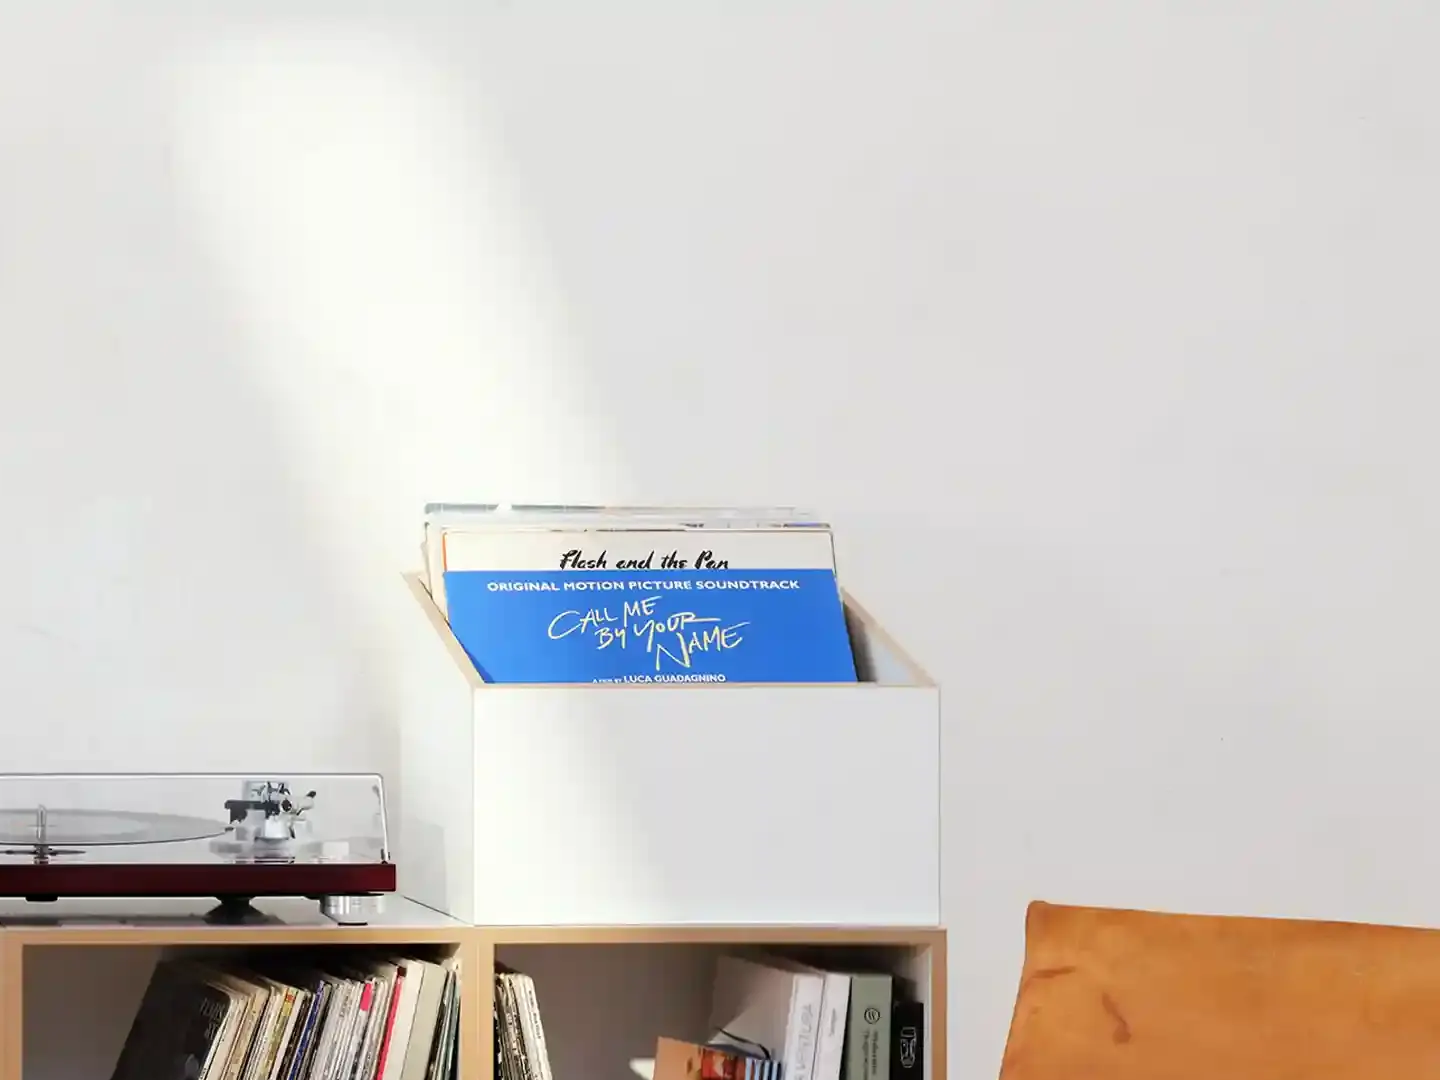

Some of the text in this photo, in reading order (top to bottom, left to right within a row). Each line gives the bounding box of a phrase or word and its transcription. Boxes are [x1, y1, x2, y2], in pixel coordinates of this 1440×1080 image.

[560, 550, 729, 569] Flash and the Pan
[487, 579, 800, 592] ORIGINAL MOTION PICTURE SOUNDTRACK
[547, 596, 662, 640] CALL ME
[655, 622, 750, 671] NAME
[623, 674, 652, 683] LUCA
